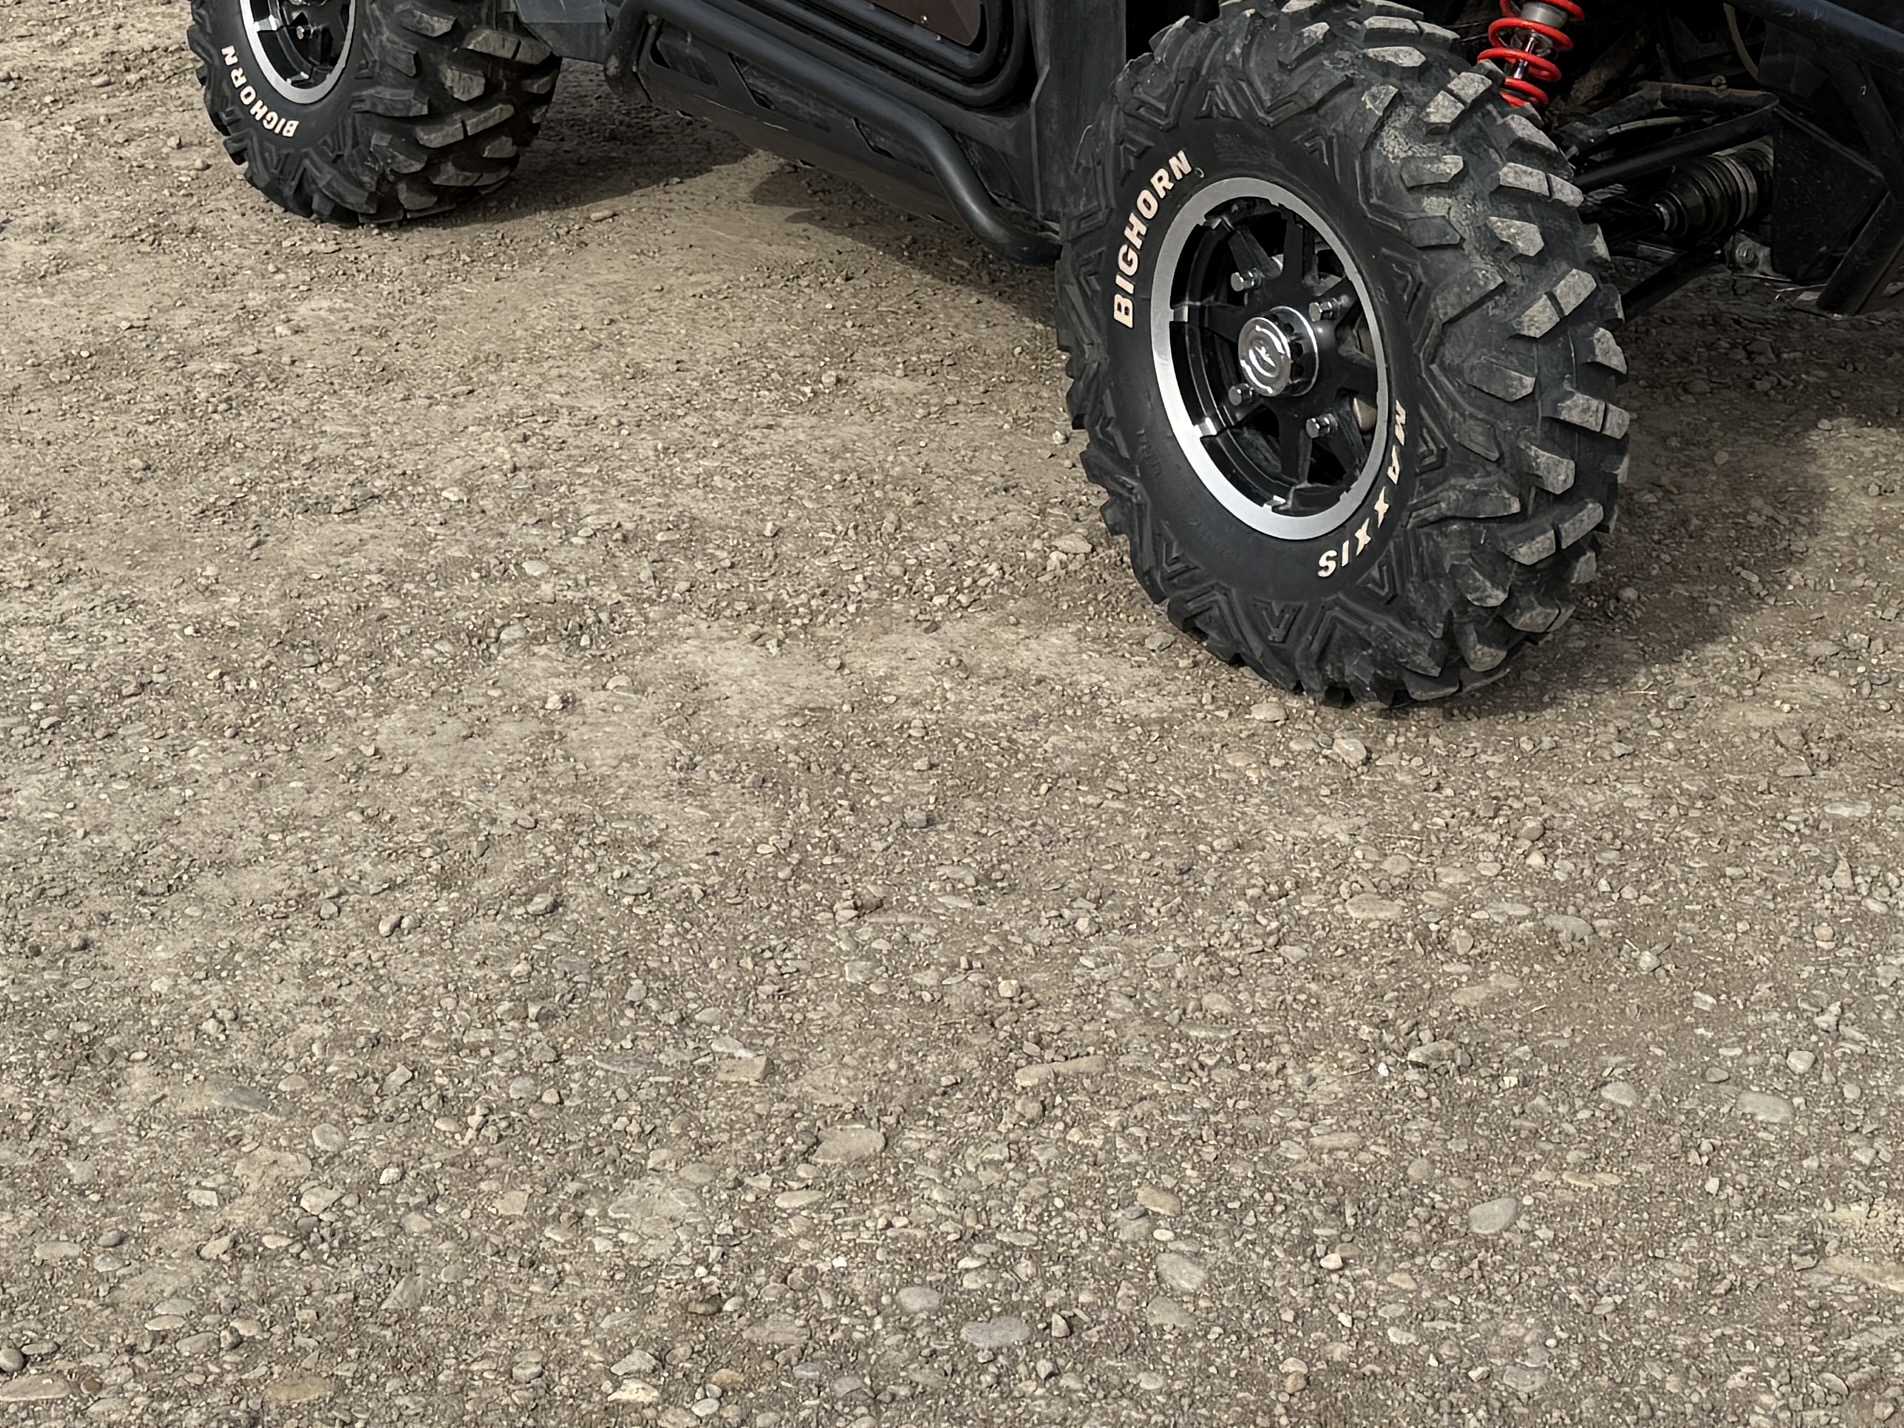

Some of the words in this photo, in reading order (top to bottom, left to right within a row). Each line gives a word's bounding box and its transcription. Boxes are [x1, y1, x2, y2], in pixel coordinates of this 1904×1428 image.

[220, 44, 300, 138] BIGHORN
[1113, 149, 1193, 330] BIGHORN
[1316, 398, 1407, 579] MAXXIS
